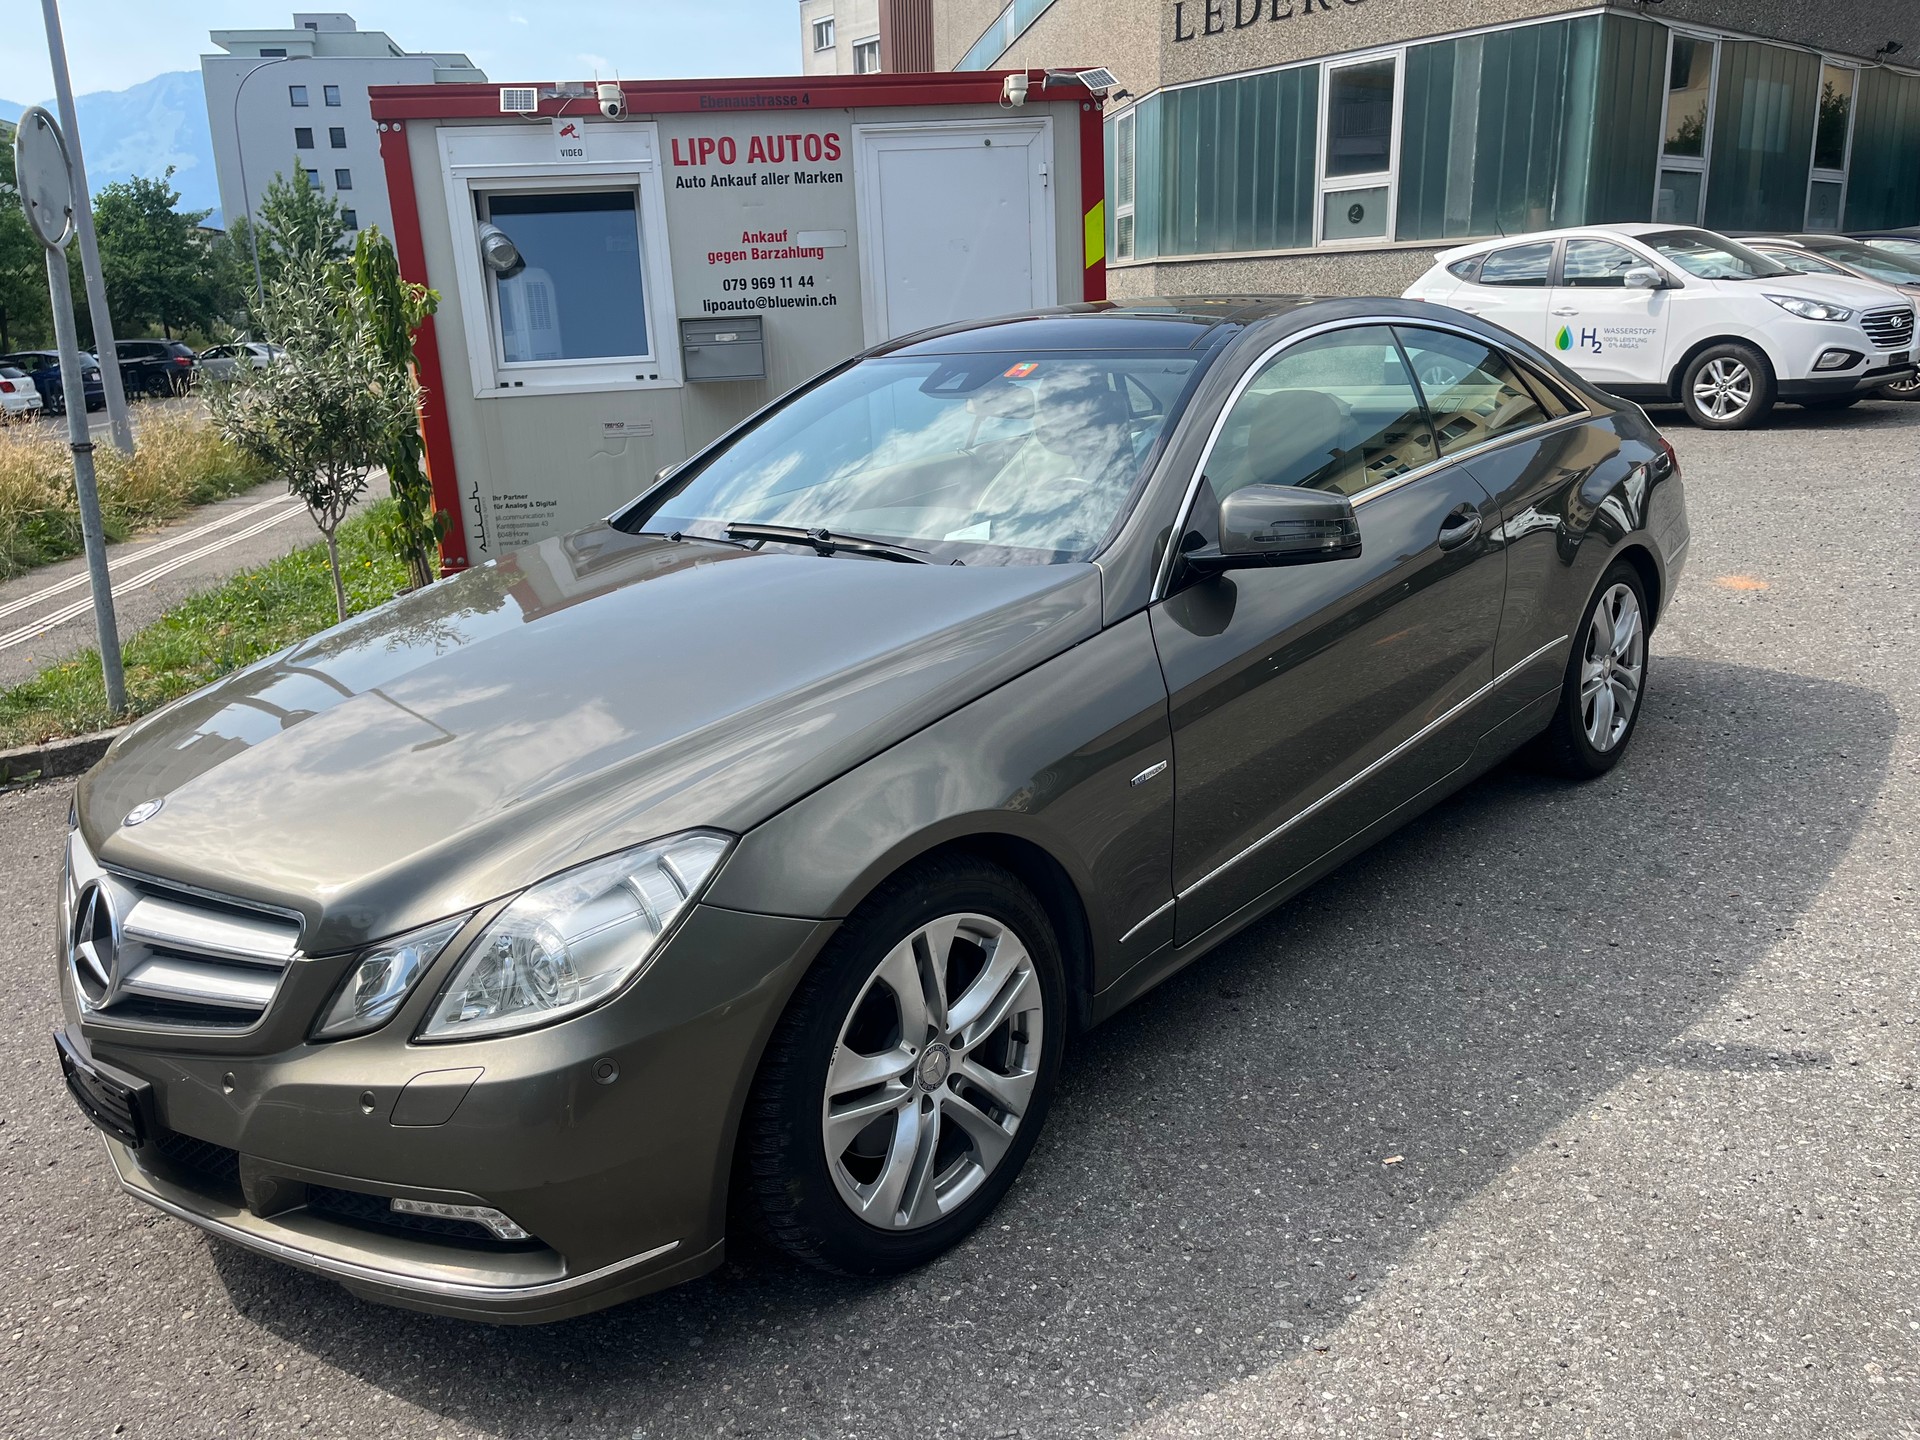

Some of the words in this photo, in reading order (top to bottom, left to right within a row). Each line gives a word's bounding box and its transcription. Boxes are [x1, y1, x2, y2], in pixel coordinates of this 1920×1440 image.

[700, 94, 798, 108] Ebenaustrasse
[802, 93, 810, 105] 4
[560, 149, 583, 157] VIDEO
[671, 136, 737, 166] LIPO
[747, 132, 841, 164] AUTOS
[676, 175, 706, 188] Auto
[710, 173, 757, 187] Ankauf
[761, 172, 790, 185] aller
[794, 171, 843, 184] Marken
[742, 229, 788, 243] Ankauf
[707, 250, 747, 264] gegen
[751, 246, 824, 260] Barzahlung
[723, 278, 747, 291] 079
[751, 276, 775, 290] 969
[780, 276, 793, 288] 11
[798, 275, 814, 287] 44
[703, 293, 837, 314] lipoauto@bluewin.ch
[505, 502, 528, 510] Analog
[535, 500, 557, 508] Digital
